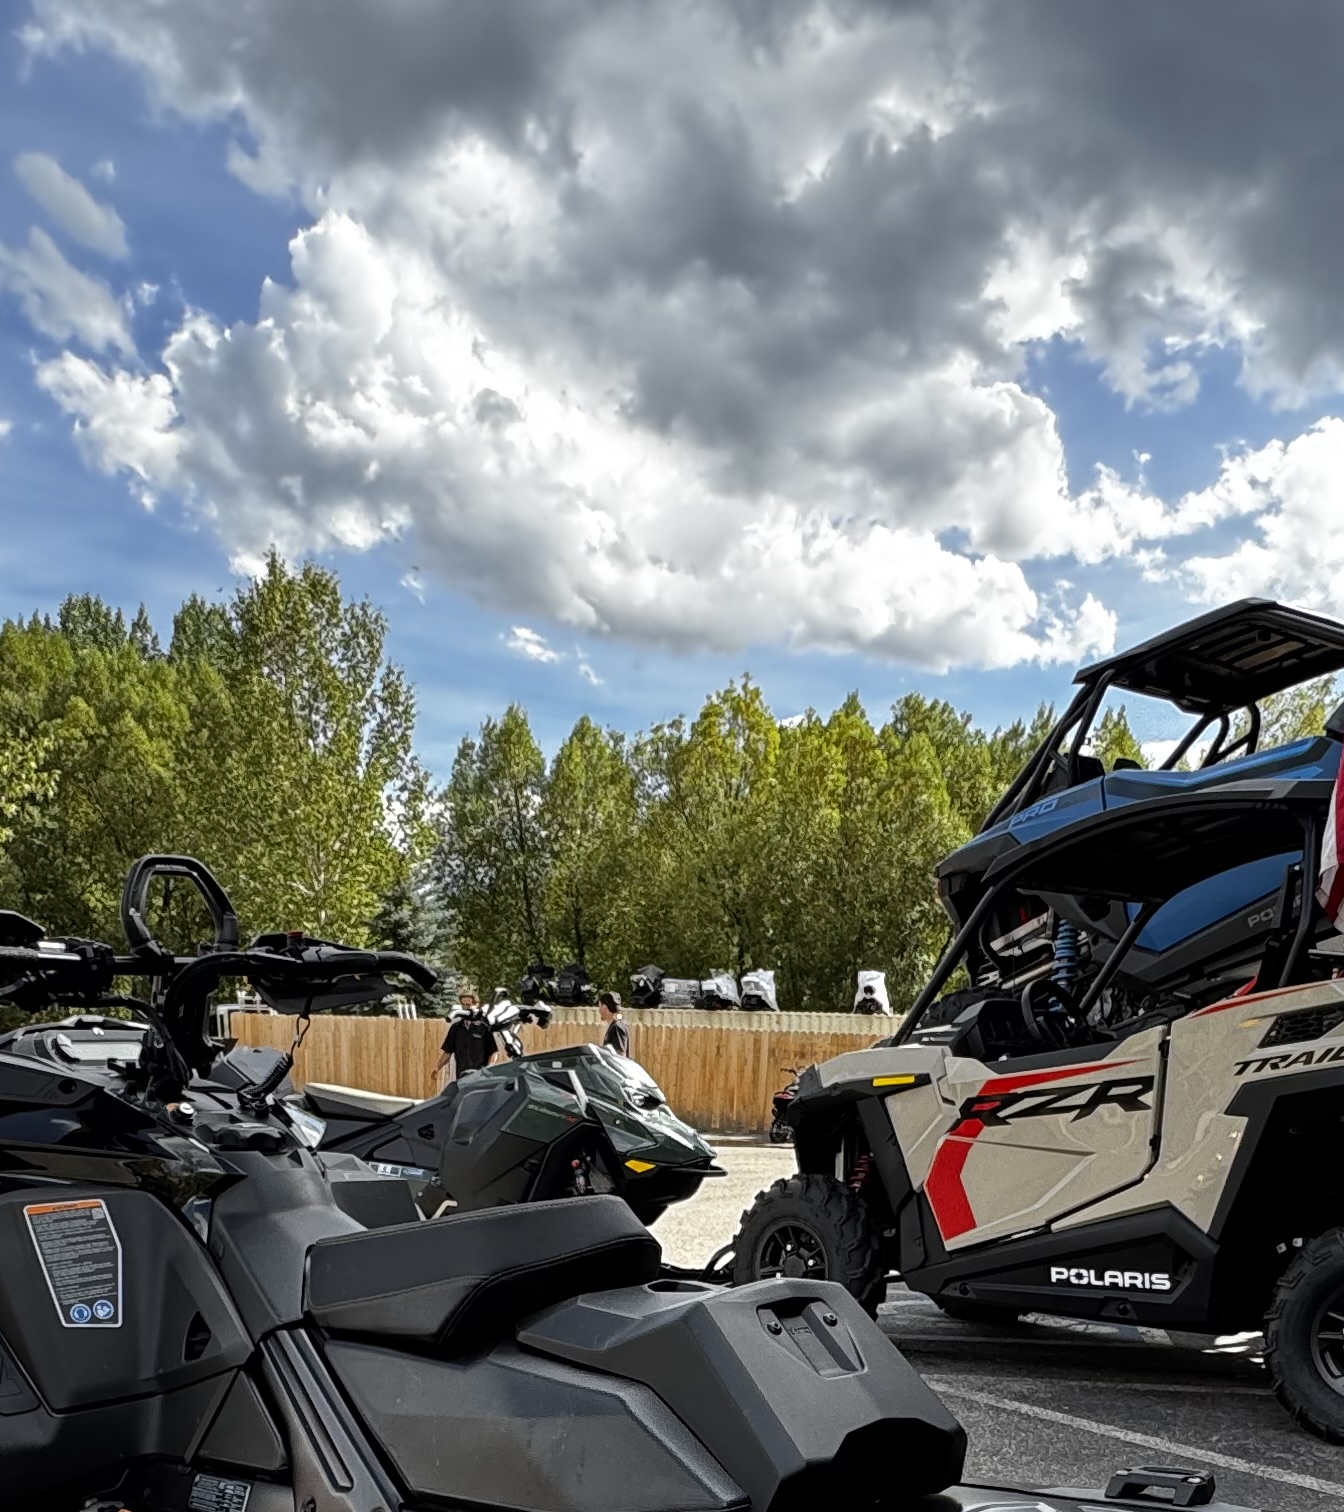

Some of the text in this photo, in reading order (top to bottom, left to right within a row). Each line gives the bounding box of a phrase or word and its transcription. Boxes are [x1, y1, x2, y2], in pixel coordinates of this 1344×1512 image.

[1008, 798, 1059, 829] PRO
[959, 1075, 1154, 1127] RZR
[1050, 1266, 1171, 1291] POLARIS
